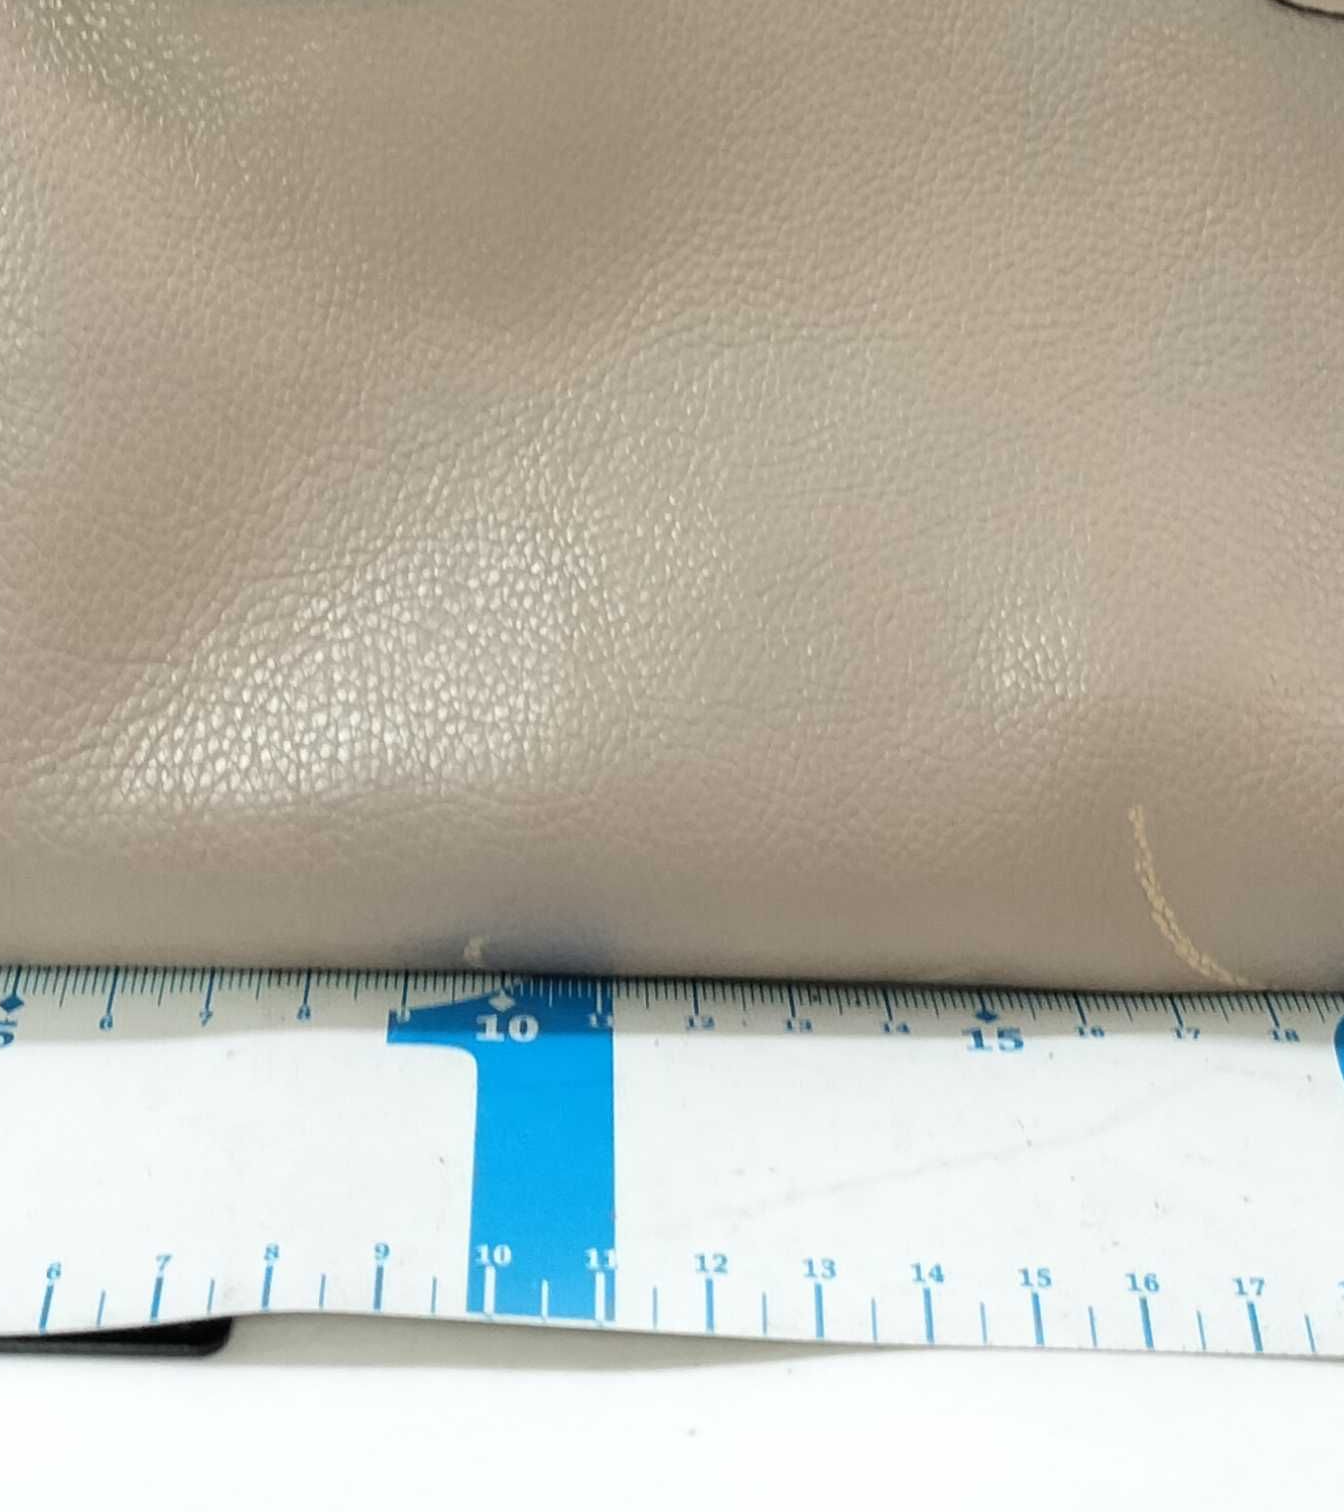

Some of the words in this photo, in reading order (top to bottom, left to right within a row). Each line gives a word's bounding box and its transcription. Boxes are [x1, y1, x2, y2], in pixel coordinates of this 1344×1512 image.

[99, 1014, 114, 1031] 6
[476, 1014, 539, 1042] 10
[962, 1027, 1025, 1053] 15
[1171, 1028, 1201, 1040] 17
[387, 972, 616, 1321] 1
[47, 1262, 61, 1281] 6
[156, 1254, 171, 1272] 7
[265, 1244, 279, 1263] 8
[375, 1244, 389, 1262] 9
[475, 1245, 512, 1266] 10
[584, 1248, 617, 1269] 11
[695, 1253, 729, 1274] 12
[803, 1259, 837, 1279] 13
[910, 1263, 944, 1284] 14
[1018, 1268, 1052, 1288] 15
[1126, 1272, 1160, 1293] 16
[1232, 1278, 1265, 1298] 17
